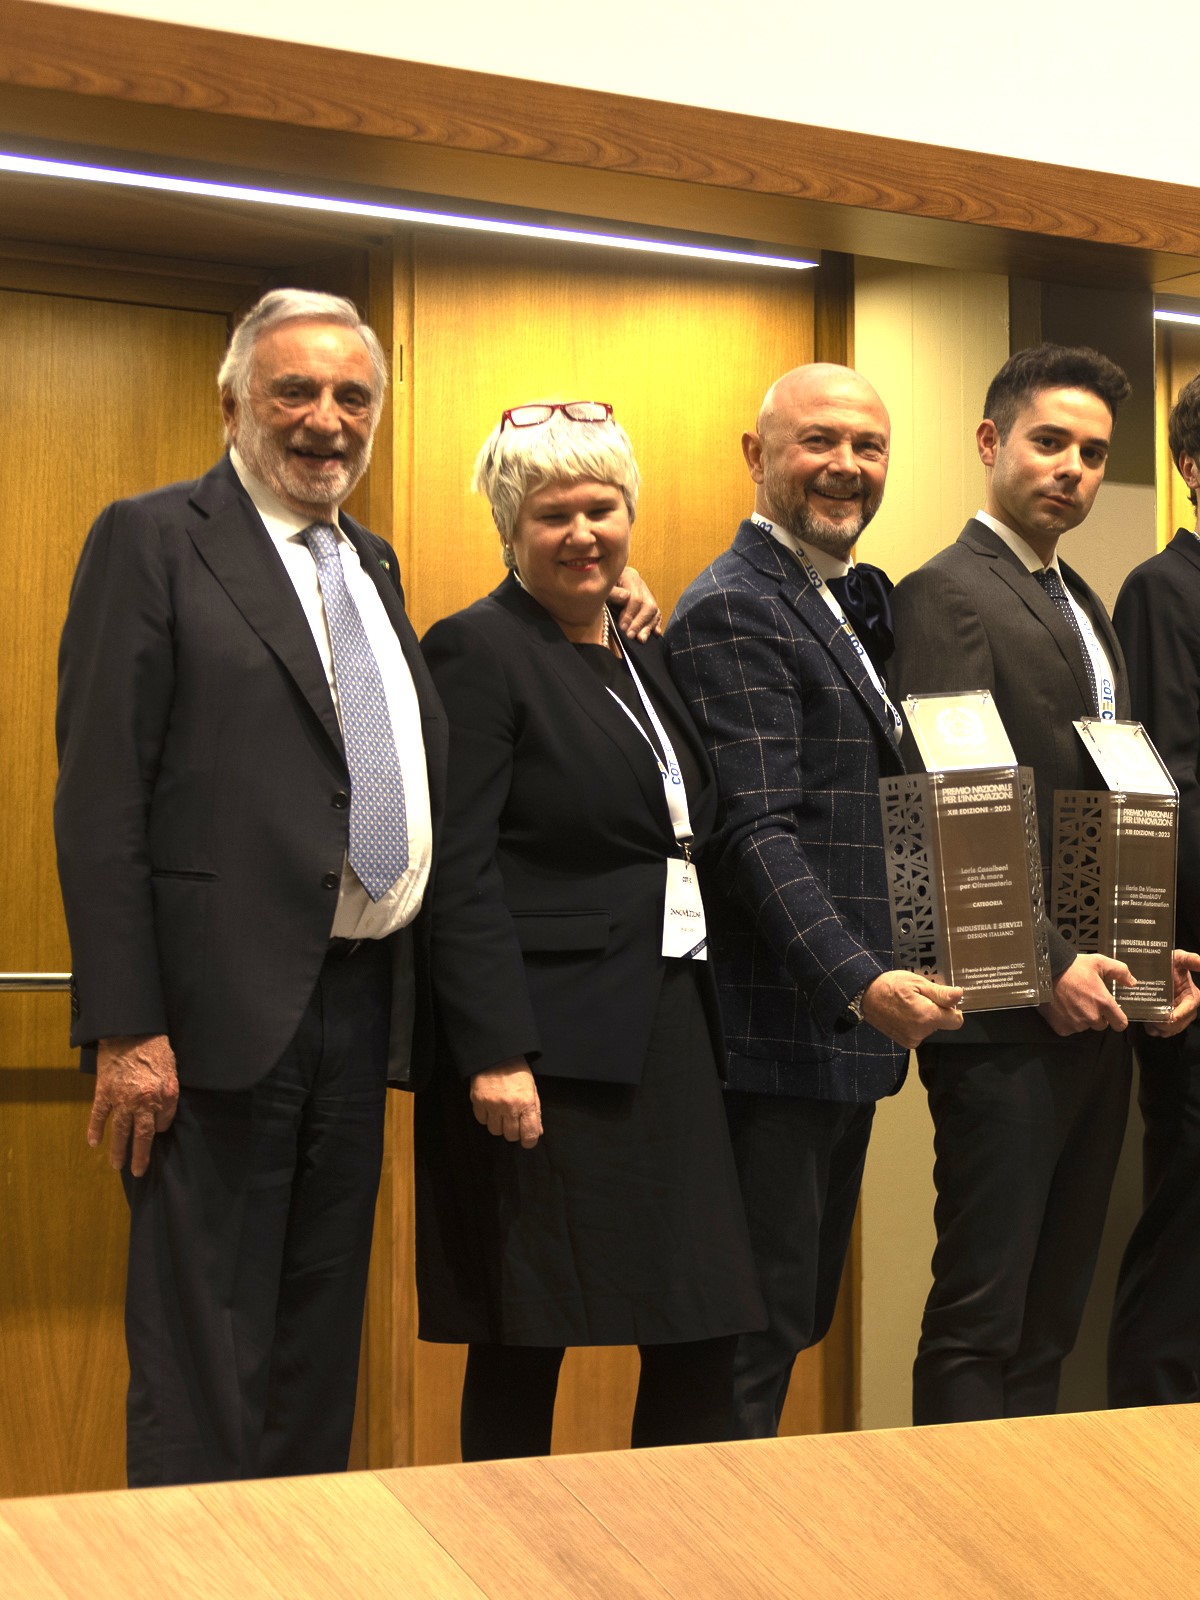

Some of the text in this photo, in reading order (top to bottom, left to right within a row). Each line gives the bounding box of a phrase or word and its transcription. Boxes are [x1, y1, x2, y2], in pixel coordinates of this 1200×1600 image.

[796, 548, 823, 589] COTEC
[1101, 678, 1114, 720] COTEC
[663, 744, 681, 785] COTC
[942, 783, 1013, 796] PREMIO NAZIONALE
[943, 791, 1013, 804] PER L'INNOVAZIONE
[960, 807, 989, 815] EDIZIONE
[1145, 810, 1173, 819] NAZIONALE
[1134, 816, 1173, 826] L'INNOVAZIONE
[972, 900, 1003, 908] CATEGORIA
[957, 923, 992, 933] INDUSTRIA
[998, 921, 1023, 929] SERVIZI
